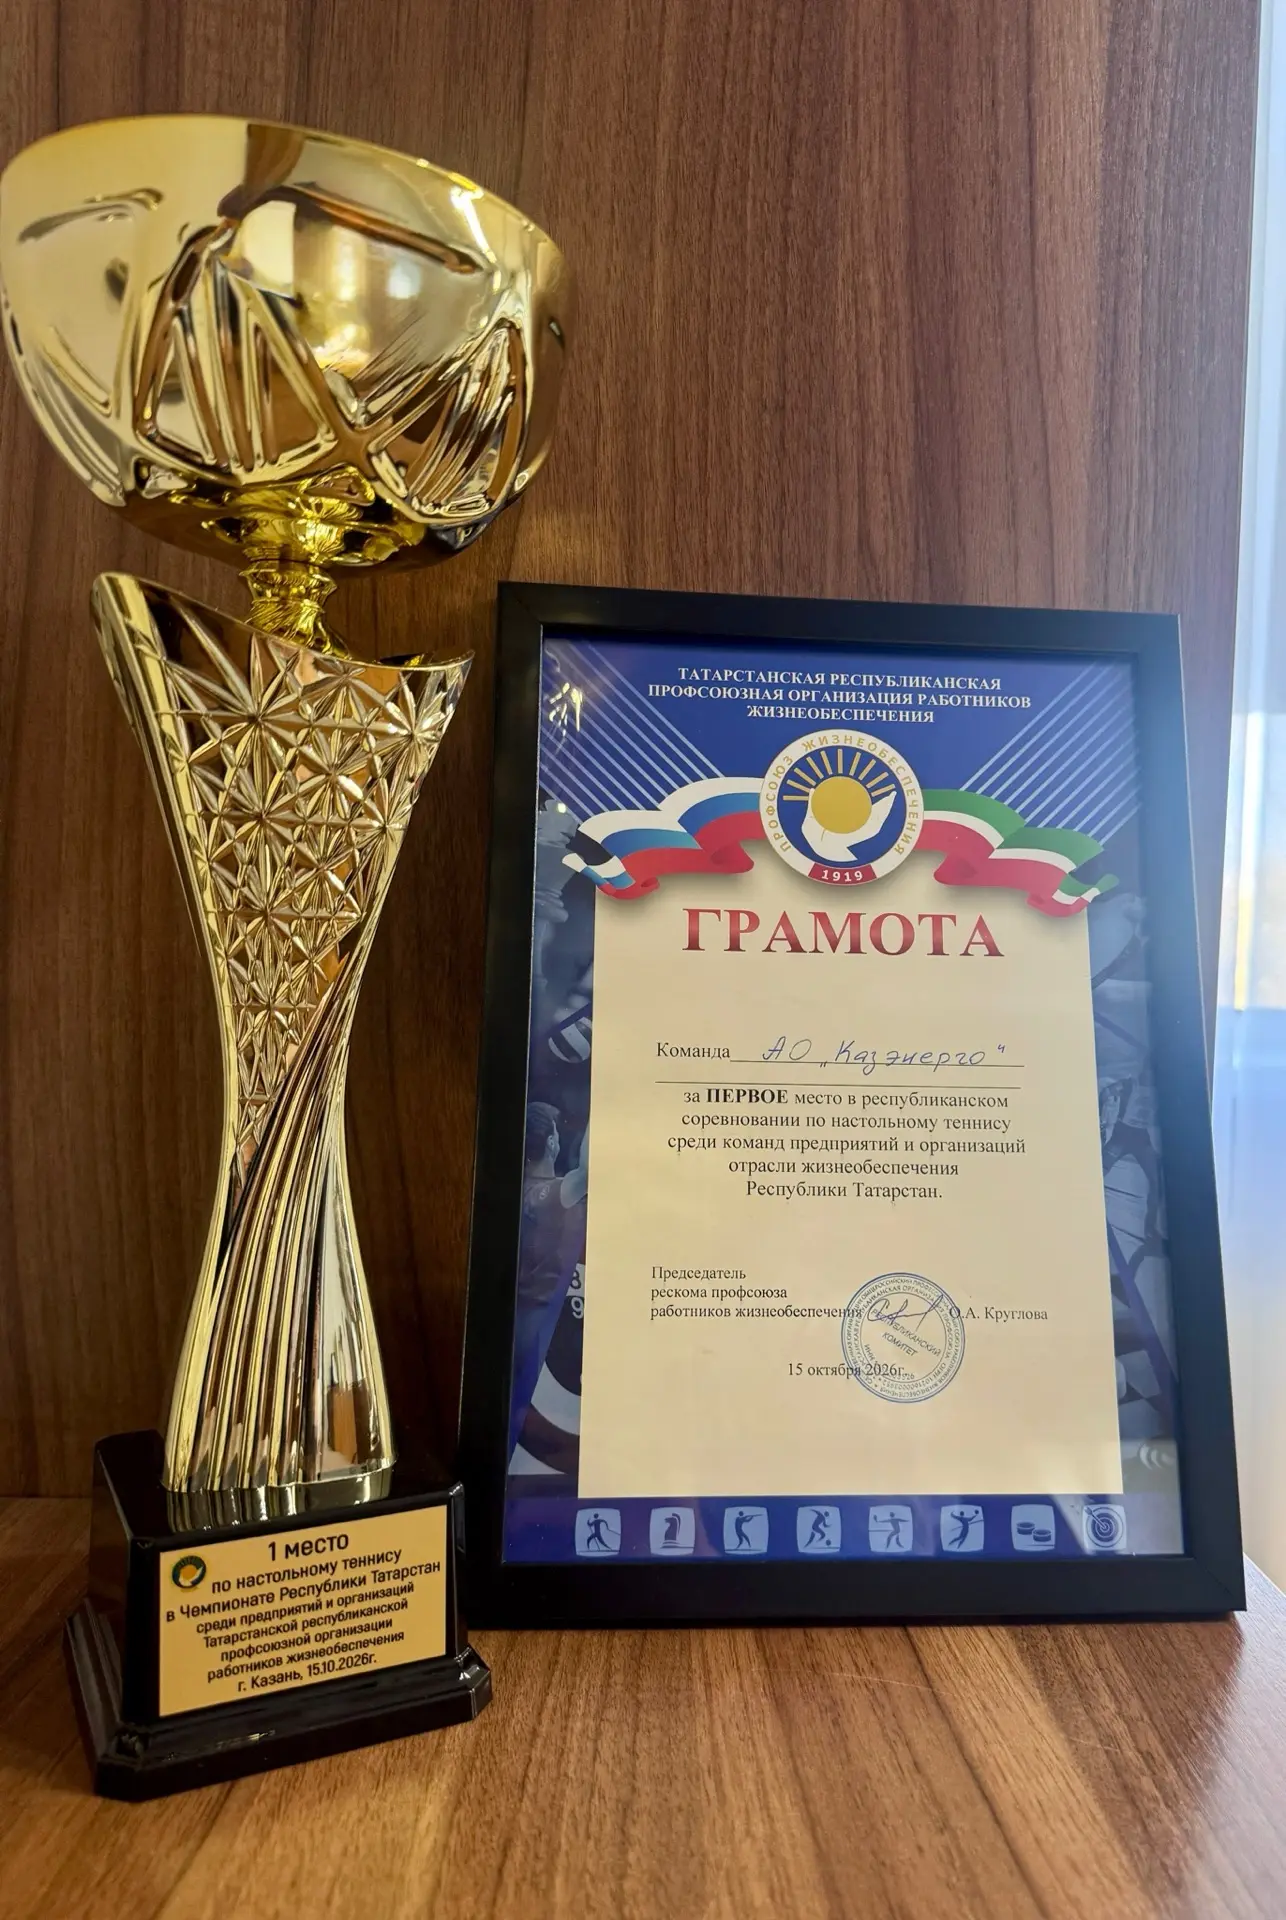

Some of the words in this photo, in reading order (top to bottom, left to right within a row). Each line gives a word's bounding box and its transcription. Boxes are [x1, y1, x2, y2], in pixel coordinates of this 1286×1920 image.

[678, 667, 826, 685] ТАТАРСТАНСКАЯ
[830, 673, 1001, 691] РЕСПУБЛИКАНСКАЯ
[648, 684, 784, 701] ПРОФСОЮЗНАЯ
[788, 688, 913, 706] ОРГАНИЗАЦИЯ
[918, 694, 1031, 709] РАБОТНИКОВ
[747, 705, 935, 723] ЖИЗНЕОБЕСПЕЧЕНИЯ
[766, 755, 793, 853] ПРОФСОЮЗ
[802, 735, 918, 855] ЖИЗНЕОБЕСПЕЧЕНИЯ
[821, 869, 863, 882] 1919
[682, 907, 1005, 959] ГРАМОТА
[656, 1042, 731, 1060] Команда
[762, 1036, 812, 1060] АО
[683, 1092, 701, 1103] за
[706, 1088, 789, 1104] ПЕРВОЕ
[794, 1093, 842, 1105] место
[848, 1096, 857, 1105] в
[862, 1091, 1009, 1109] республиканском
[681, 1114, 801, 1129] соревновании
[805, 1116, 826, 1128] по
[831, 1116, 938, 1133] настольному
[943, 1117, 1012, 1134] теннису
[667, 1136, 716, 1152] среди
[722, 1138, 785, 1152] команд
[790, 1137, 899, 1154] предприятий
[904, 1140, 914, 1151] и
[919, 1139, 1026, 1156] организаций
[728, 1161, 797, 1177] отрасли
[801, 1159, 959, 1176] жизнеобеспечения
[746, 1180, 847, 1200] Республики
[853, 1182, 943, 1201] Татарстан.
[651, 1266, 747, 1282] Председатель
[651, 1288, 707, 1301] рескома
[711, 1285, 788, 1302] профсоюза
[650, 1304, 731, 1320] работников
[735, 1304, 862, 1319] жизнеобеспечения
[949, 1306, 980, 1320] О.А.
[984, 1307, 1048, 1323] Круглова
[881, 1331, 918, 1357] КОМИТЕТ
[788, 1363, 803, 1376] 15
[807, 1362, 860, 1380] октября
[268, 1541, 276, 1561] 1
[284, 1533, 350, 1560] место
[211, 1580, 231, 1594] по
[236, 1559, 338, 1589] настольному
[342, 1549, 402, 1569] теннису
[166, 1610, 175, 1622] в
[180, 1593, 276, 1618] Чемпионате
[279, 1576, 367, 1601] Республики
[371, 1560, 441, 1584] Татарстан
[196, 1618, 237, 1635] среди
[240, 1599, 323, 1626] предприятий
[326, 1599, 333, 1609] и
[336, 1582, 414, 1608] организаций
[203, 1618, 298, 1649] Татарстанской
[302, 1597, 408, 1630] республиканской
[220, 1635, 311, 1662] профсоюзной
[314, 1618, 393, 1644] организации
[207, 1654, 284, 1683] работников
[286, 1631, 405, 1664] жизнеобеспечения
[237, 1680, 247, 1692] г.
[251, 1671, 303, 1689] Казань,
[307, 1652, 377, 1677] 15.10.2026г.
